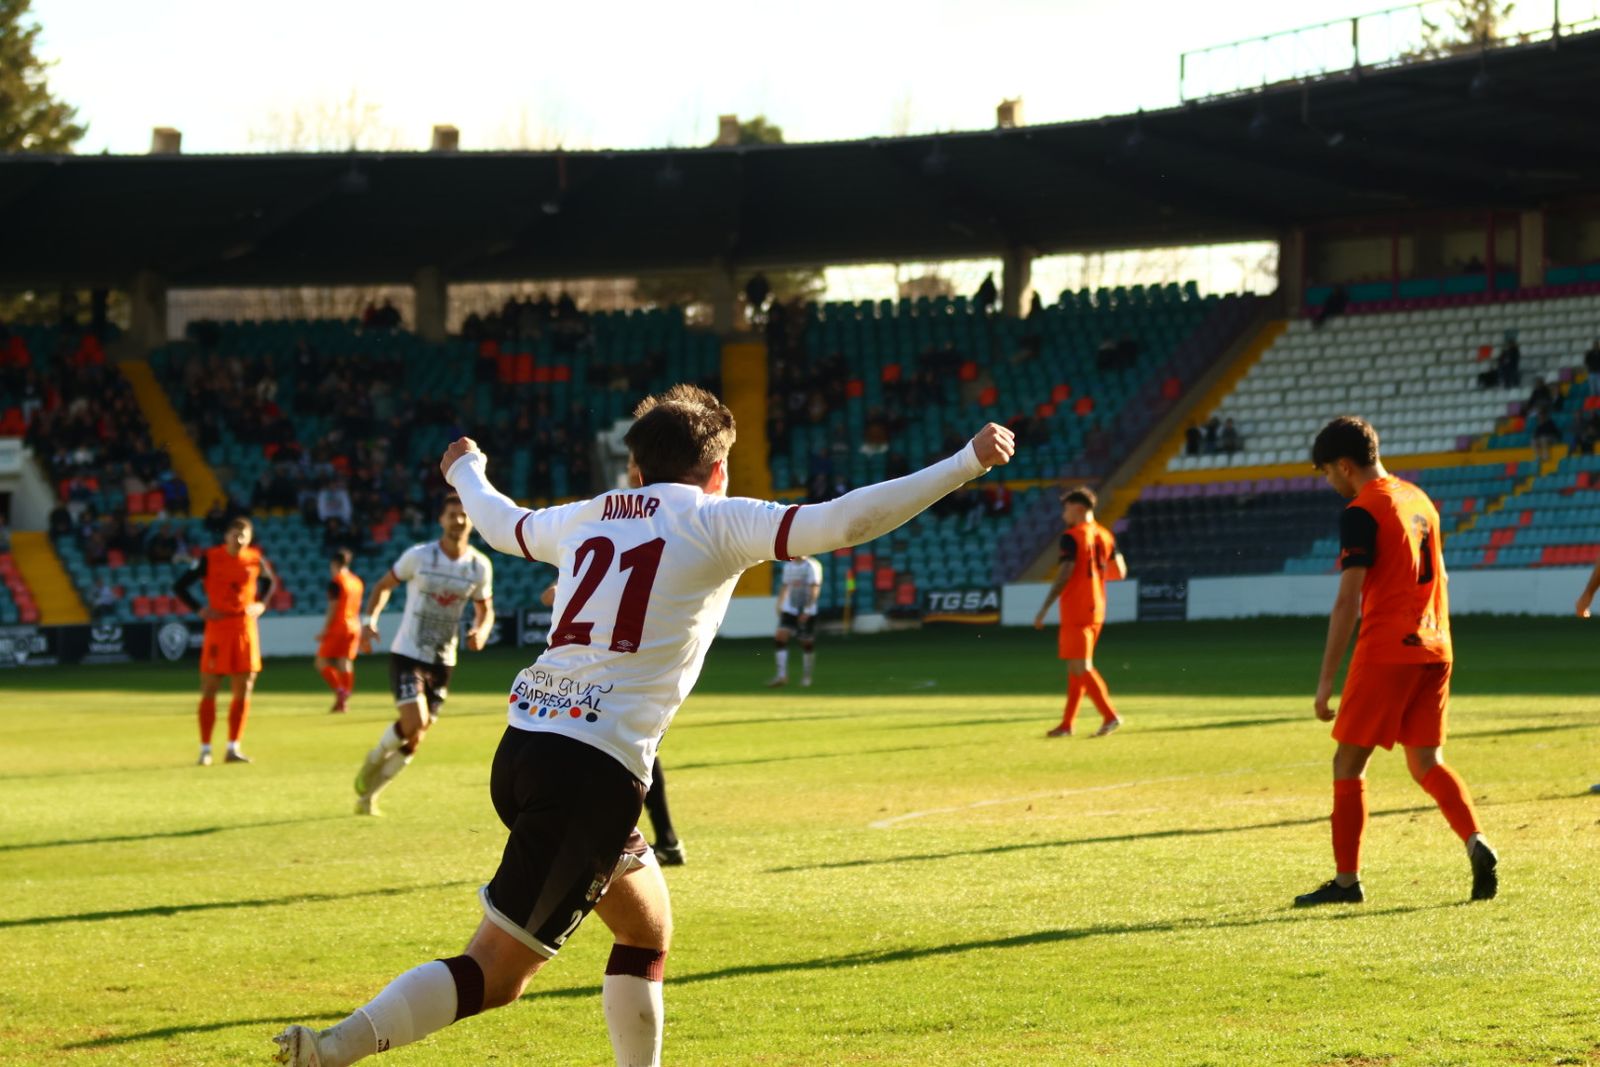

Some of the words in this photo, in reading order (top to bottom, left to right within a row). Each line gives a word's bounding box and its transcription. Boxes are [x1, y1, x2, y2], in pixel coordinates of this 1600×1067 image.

[600, 494, 661, 521] AIMAR
[547, 536, 666, 653] 21
[928, 591, 998, 611] TGSA
